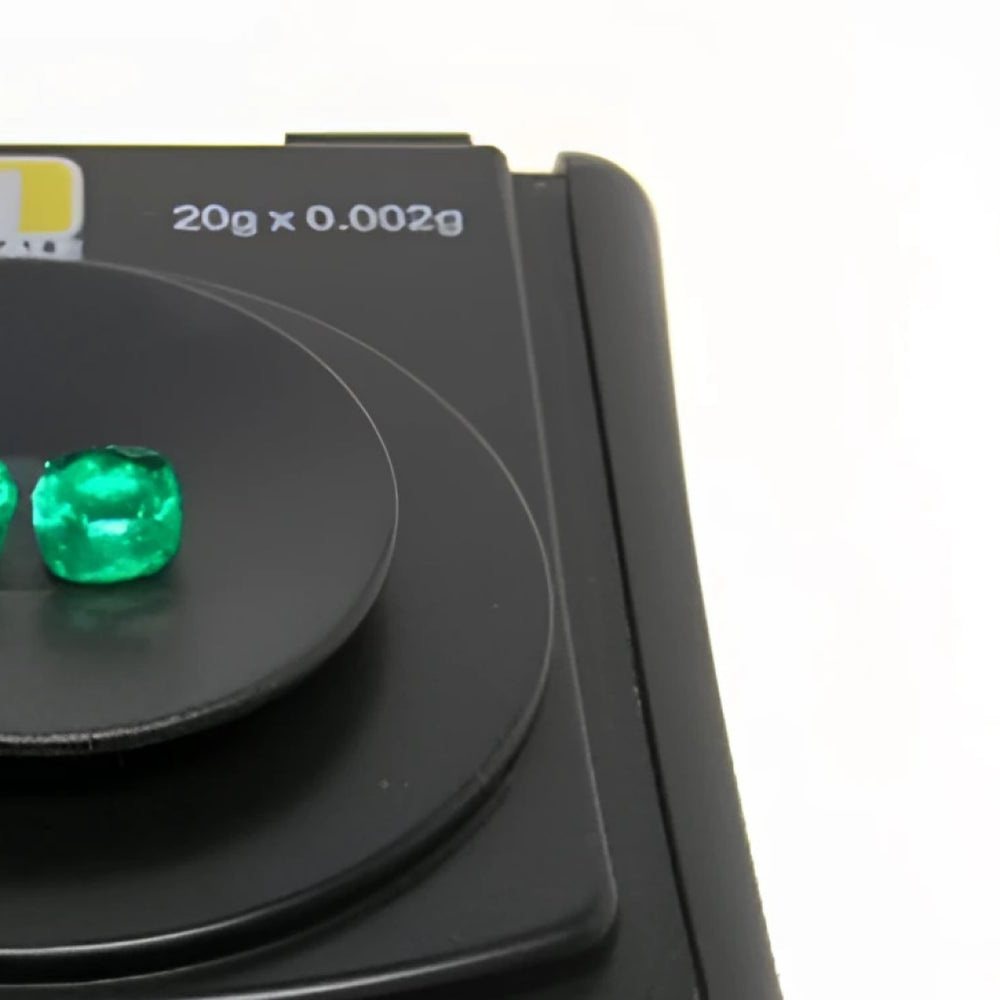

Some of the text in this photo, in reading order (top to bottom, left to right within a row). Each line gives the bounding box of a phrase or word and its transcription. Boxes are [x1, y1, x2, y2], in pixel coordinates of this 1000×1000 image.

[172, 203, 464, 237] 20g x 0.002g
